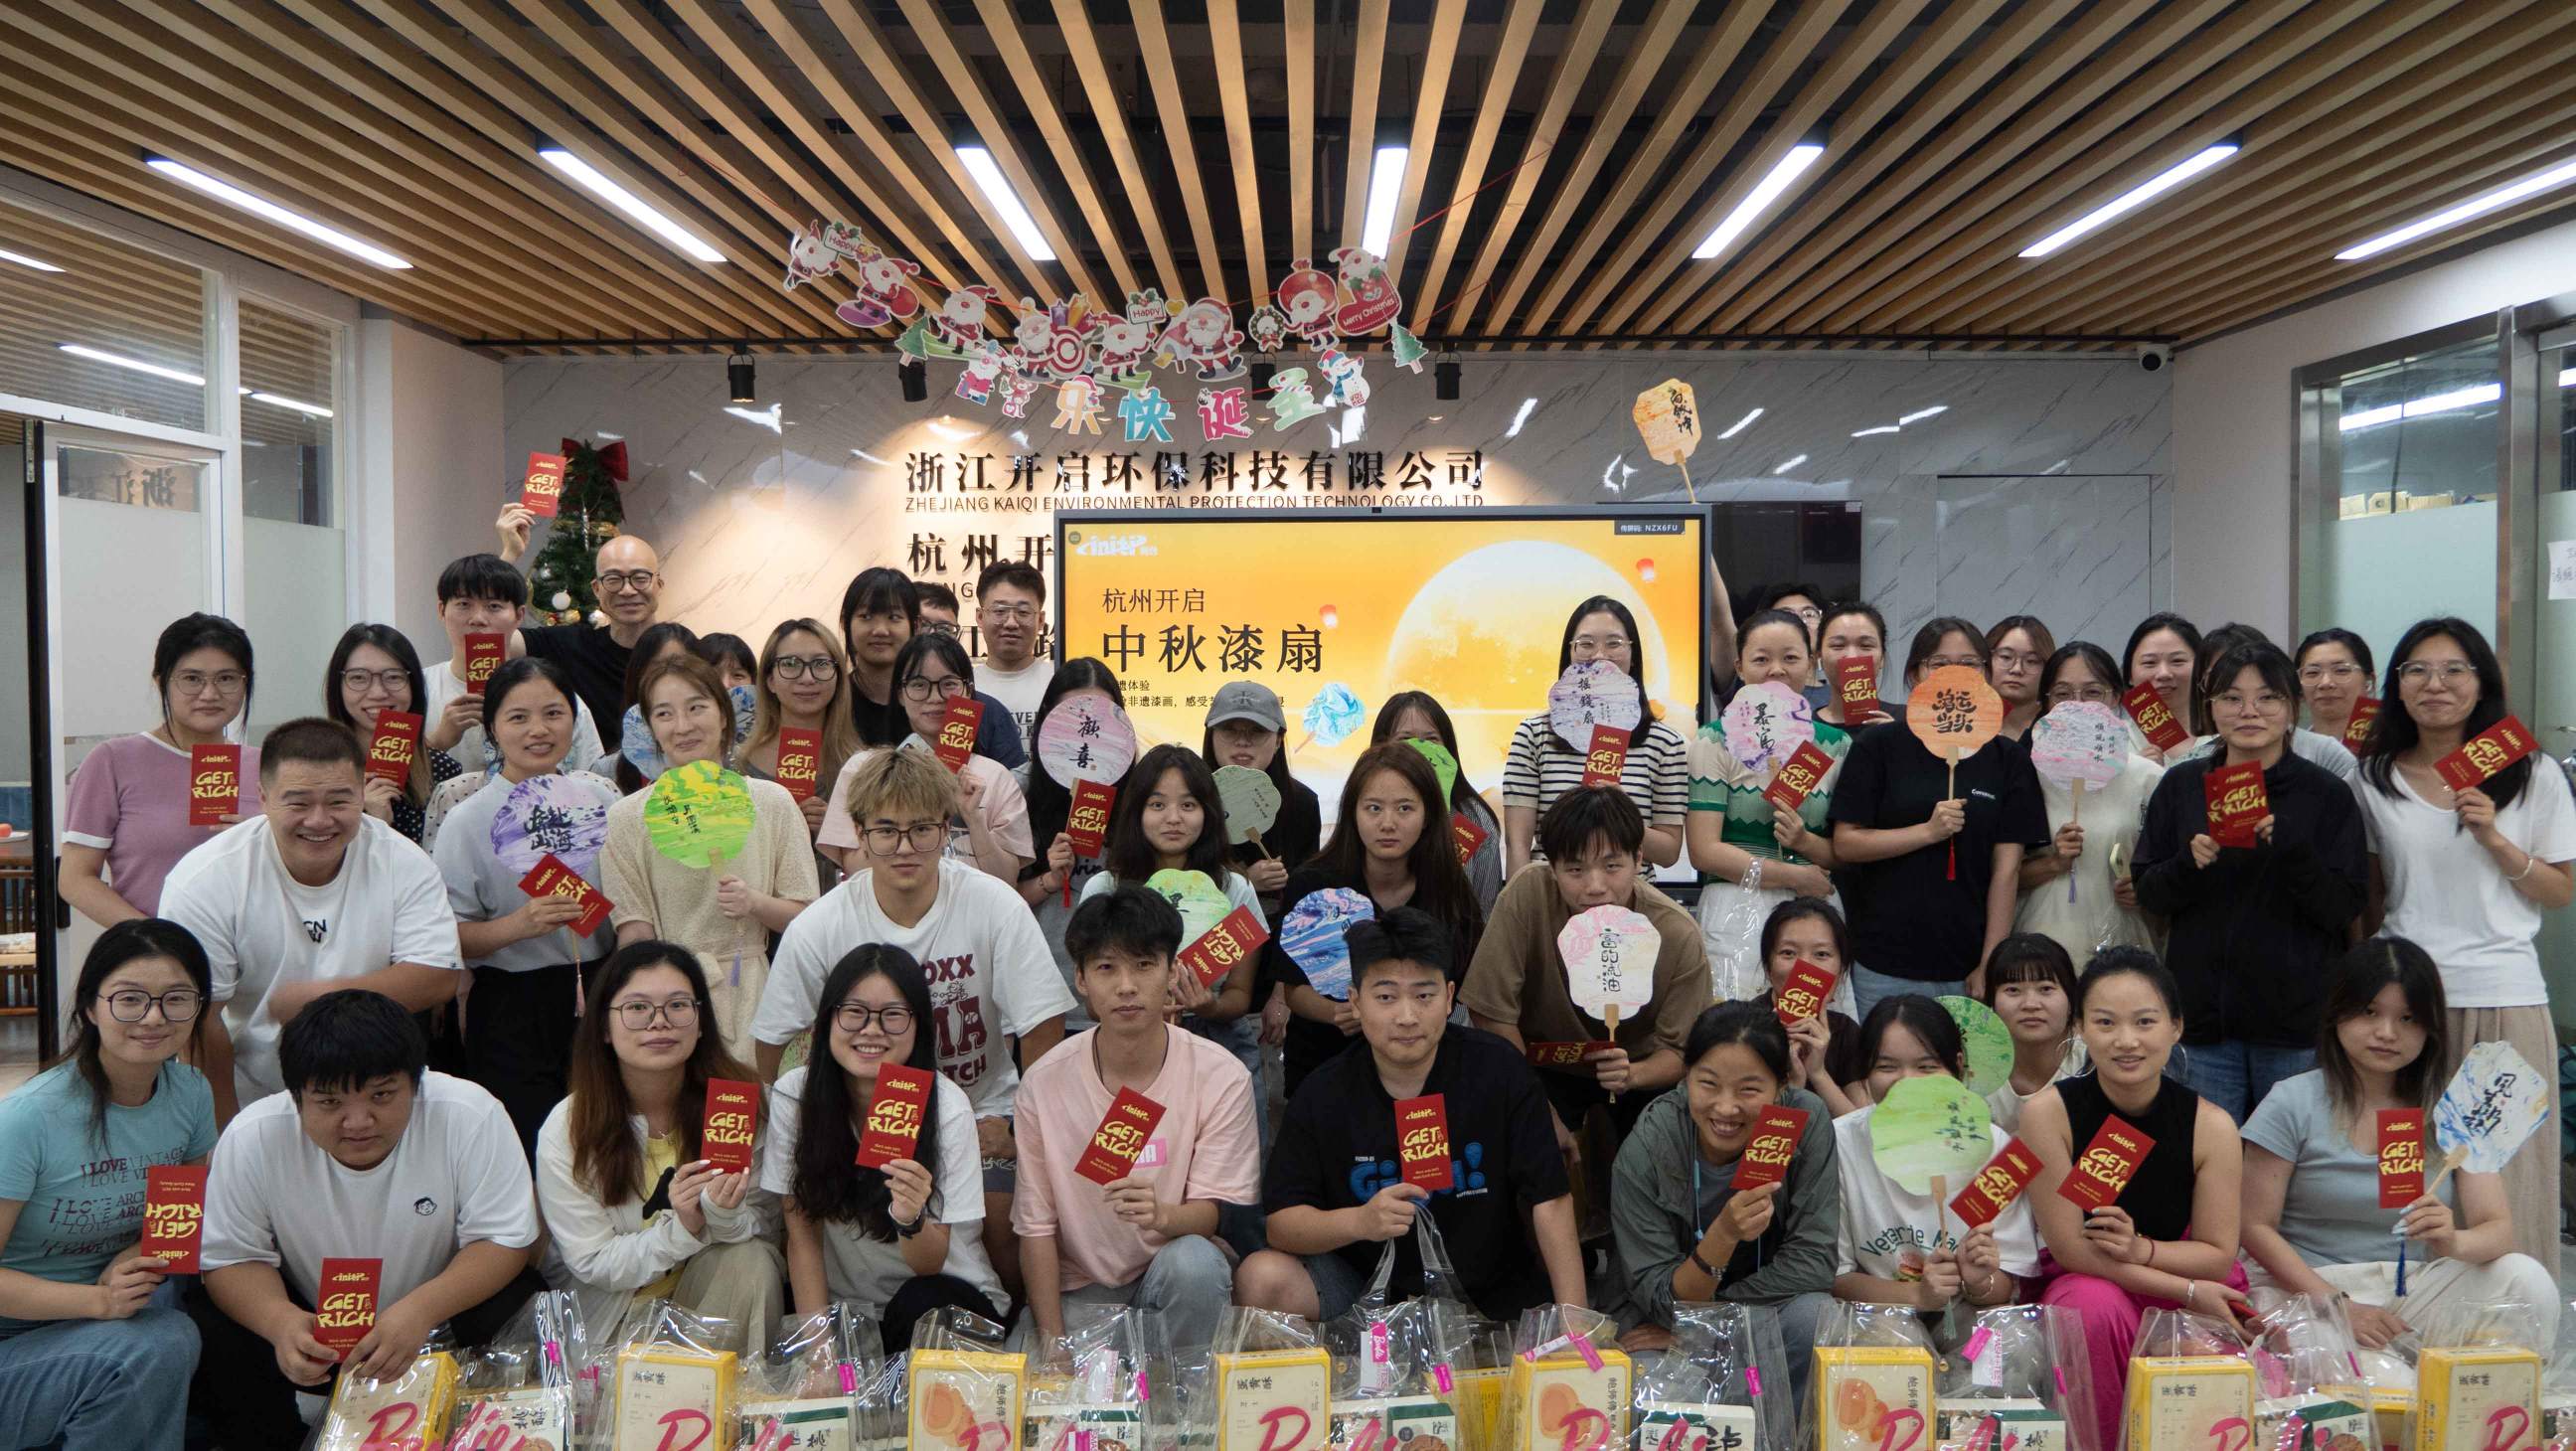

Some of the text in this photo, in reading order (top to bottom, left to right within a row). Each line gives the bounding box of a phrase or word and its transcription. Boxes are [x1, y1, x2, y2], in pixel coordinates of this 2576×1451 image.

[1132, 307, 1161, 319] Happy
[529, 473, 558, 485] GET
[905, 451, 1484, 493] 浙江开启环保科技有限公司
[525, 483, 560, 496] RICH
[905, 497, 989, 513] ZHEJIANG
[994, 496, 1039, 513] KAIQI
[1044, 496, 1185, 511] ENVIRONMENTAL
[1191, 495, 1297, 509] PROTECTION
[1304, 495, 1415, 508] TECHNOLOGY
[1102, 588, 1206, 613] 杭州开启
[1102, 624, 1323, 674] 中秋漆扇
[466, 669, 493, 681] RIC
[1844, 678, 1870, 691] GET
[1842, 689, 1876, 702] RICH
[2138, 702, 2162, 723] GET
[2144, 710, 2173, 730] RICH
[944, 722, 972, 737] GET
[375, 735, 409, 750] GET
[939, 733, 973, 750] RICH
[2476, 737, 2507, 764] GET
[371, 747, 411, 763] RICH
[780, 754, 811, 767] GET
[1590, 749, 1620, 763] GET
[2463, 742, 2496, 777] RICH
[777, 766, 816, 779] RICH
[1587, 761, 1622, 775] RICH
[1786, 763, 1815, 783] GET
[195, 771, 233, 785] GET
[1778, 770, 1811, 797] RICH
[192, 785, 238, 798] RICH
[2223, 784, 2259, 804] GET
[1074, 806, 1105, 821] GET
[2221, 796, 2265, 814] RICH
[1070, 817, 1106, 833] RICH
[550, 876, 574, 897] ET
[1212, 922, 1243, 959] RICH
[1204, 936, 1232, 964] GET
[1785, 988, 1818, 1008] GET
[875, 1099, 917, 1120] GET
[709, 1112, 748, 1129] GET
[868, 1116, 919, 1138] RICH
[705, 1128, 752, 1145] RICH
[1104, 1120, 1143, 1144] GET
[1403, 1126, 1440, 1146] GET
[1095, 1132, 1141, 1162] RICH
[1400, 1142, 1448, 1162] RICH
[1752, 1135, 1791, 1151] GET
[2381, 1141, 2417, 1159] GET
[1745, 1149, 1790, 1165] RICH
[2089, 1147, 2130, 1173] GET
[89, 1158, 127, 1175] LOVE
[2079, 1157, 2125, 1191] RICH
[2378, 1158, 2424, 1175] RICH
[1986, 1166, 2016, 1192] GET
[1974, 1174, 2007, 1207] RICH
[145, 1203, 202, 1219] RICH
[150, 1219, 197, 1238] GET
[322, 1292, 370, 1310] GET
[317, 1311, 376, 1328] RICH
